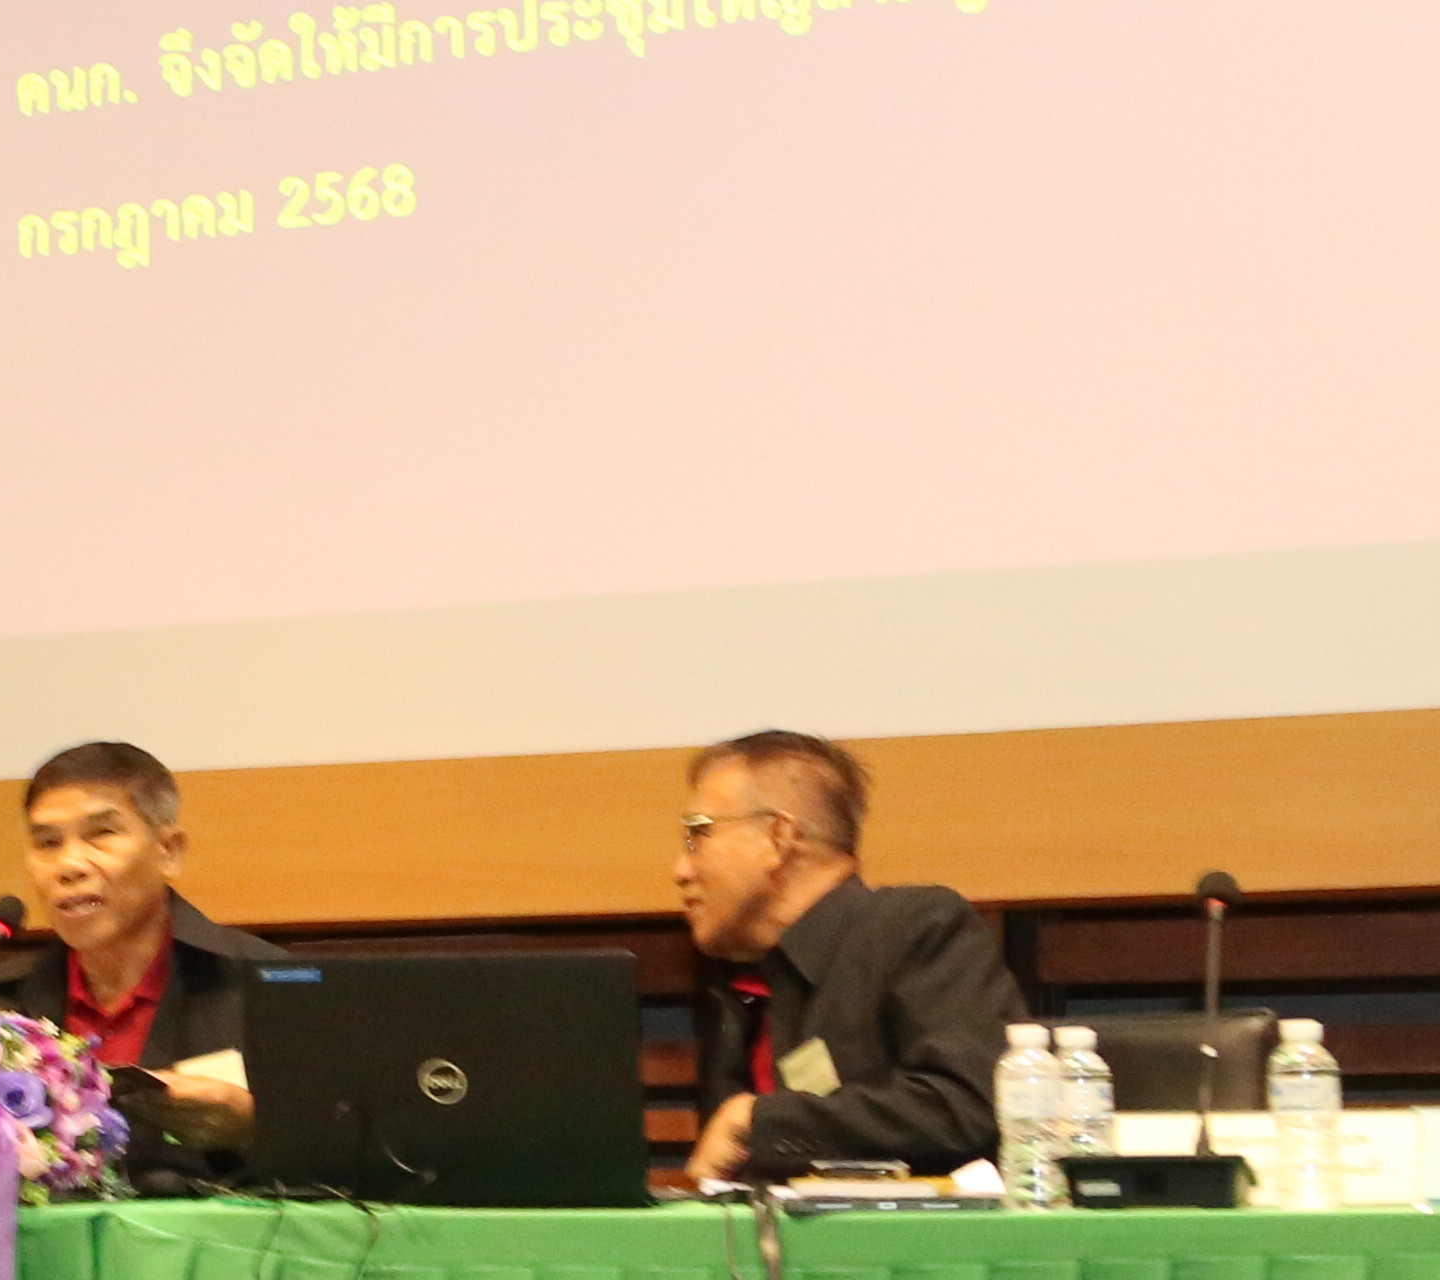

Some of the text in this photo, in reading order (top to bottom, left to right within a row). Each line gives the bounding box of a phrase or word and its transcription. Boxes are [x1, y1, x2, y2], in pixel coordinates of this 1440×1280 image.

[18, 163, 417, 268] กรกฎาคม 2568
